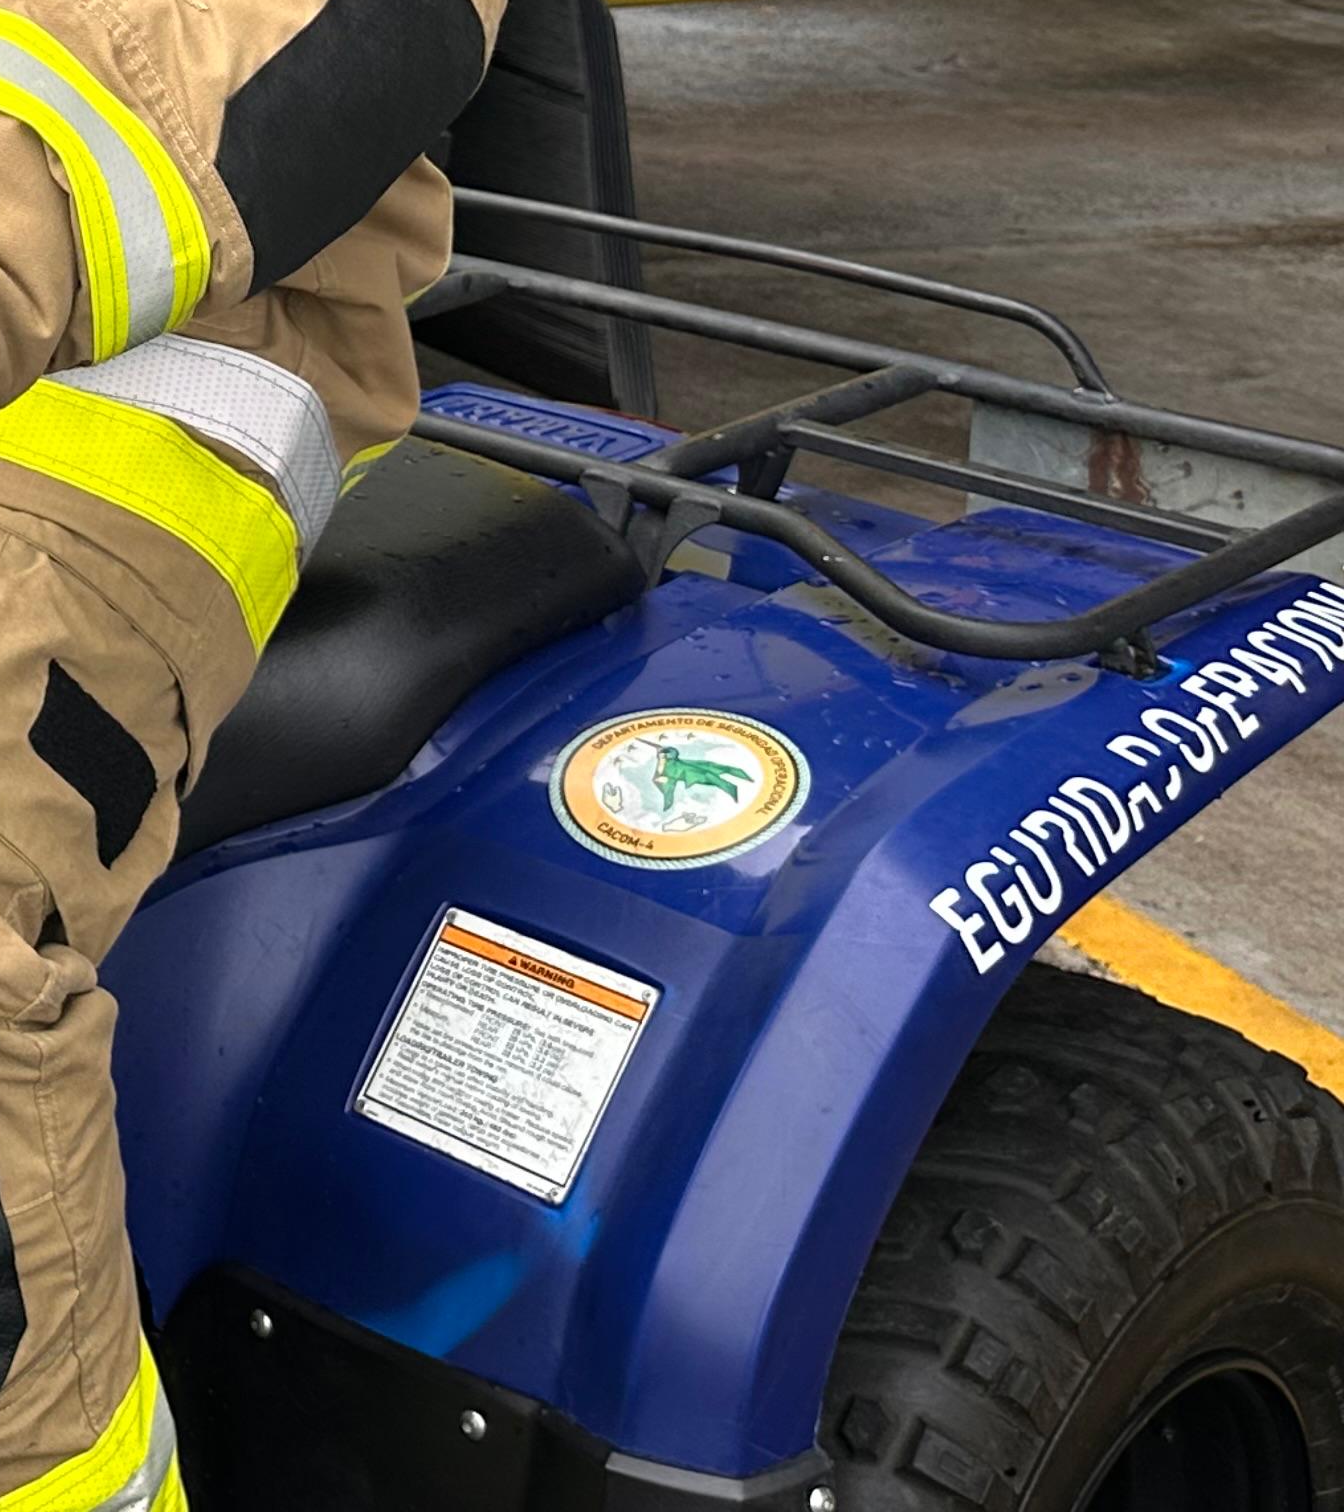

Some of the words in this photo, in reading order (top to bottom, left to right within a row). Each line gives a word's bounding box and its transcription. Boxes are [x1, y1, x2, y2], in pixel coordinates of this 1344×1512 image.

[696, 718, 716, 727] DE
[597, 821, 654, 851] CACOM-4
[519, 958, 576, 990] WARNING
